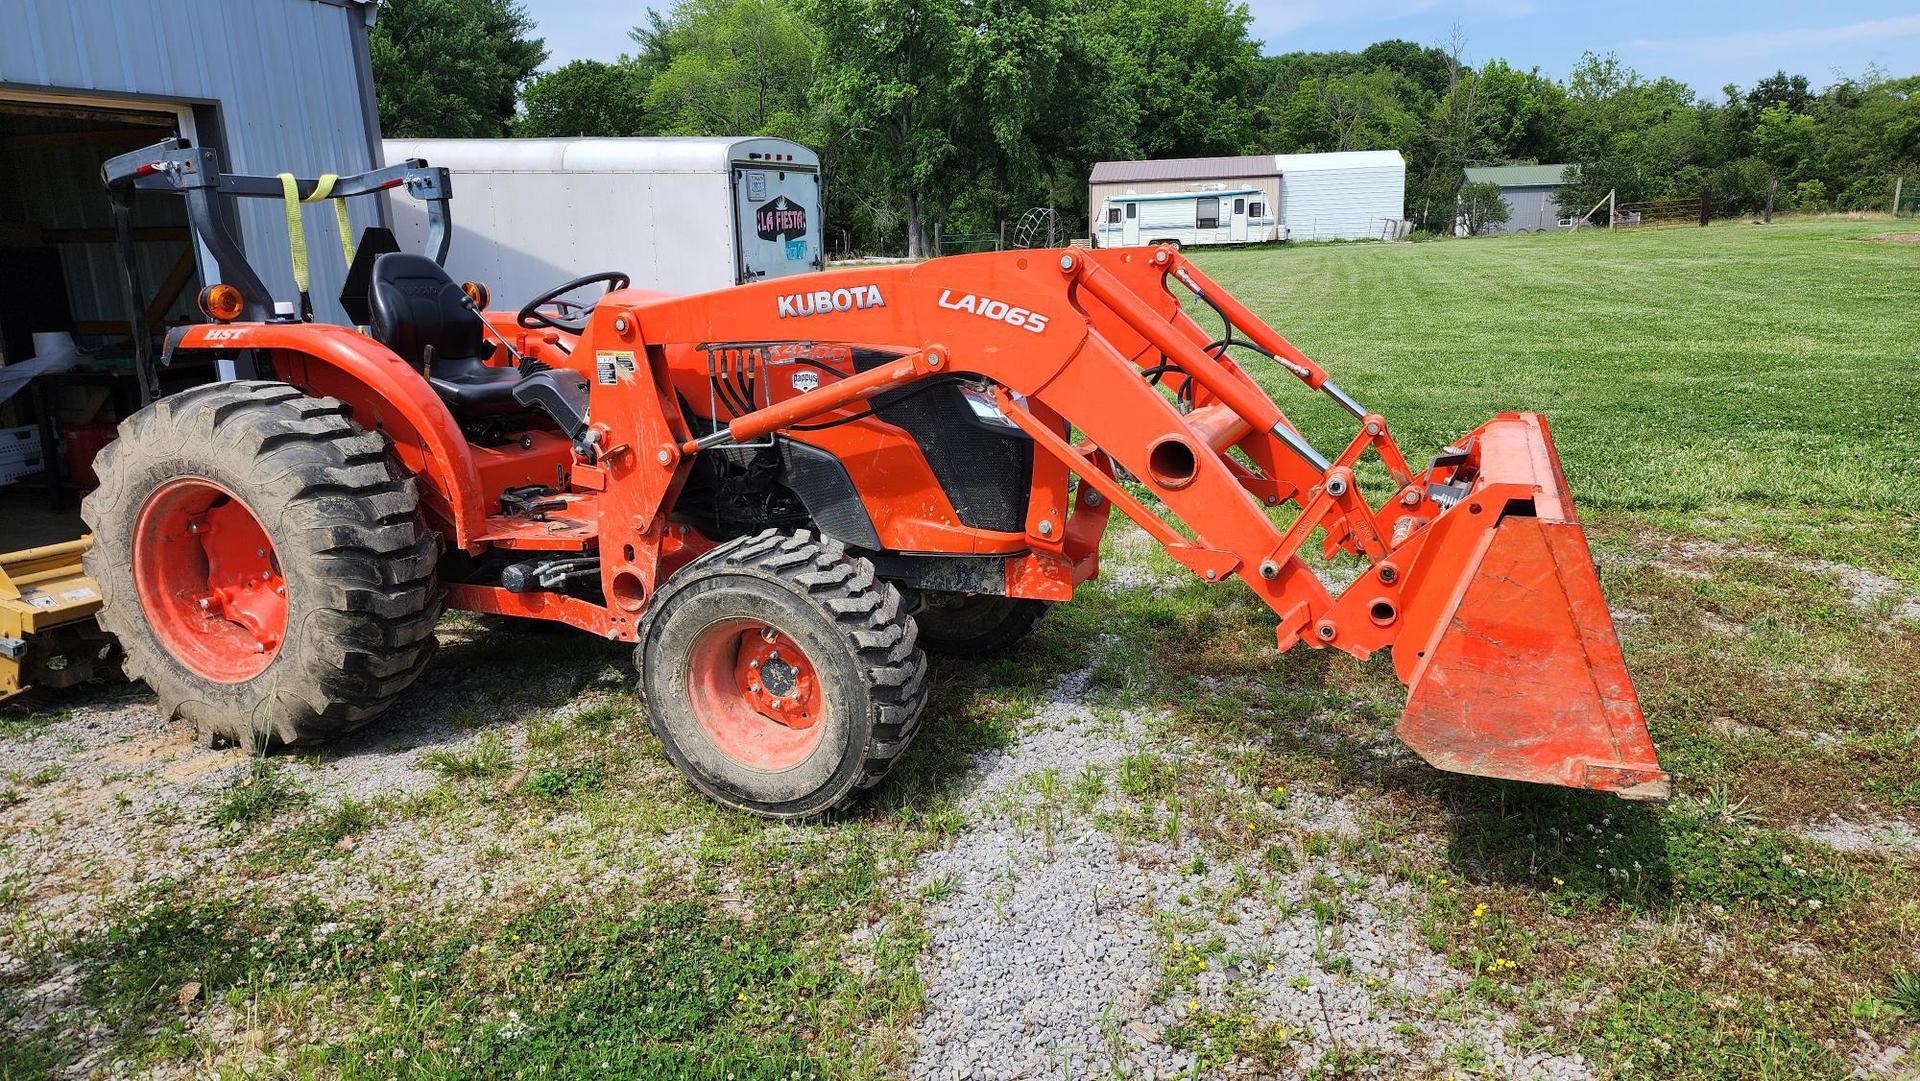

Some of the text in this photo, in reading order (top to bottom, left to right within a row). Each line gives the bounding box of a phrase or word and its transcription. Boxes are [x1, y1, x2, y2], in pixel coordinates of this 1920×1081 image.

[761, 211, 804, 233] LA FIESTA
[778, 285, 885, 318] KUBOTA
[938, 290, 1049, 333] LA1065
[203, 329, 249, 340] HST
